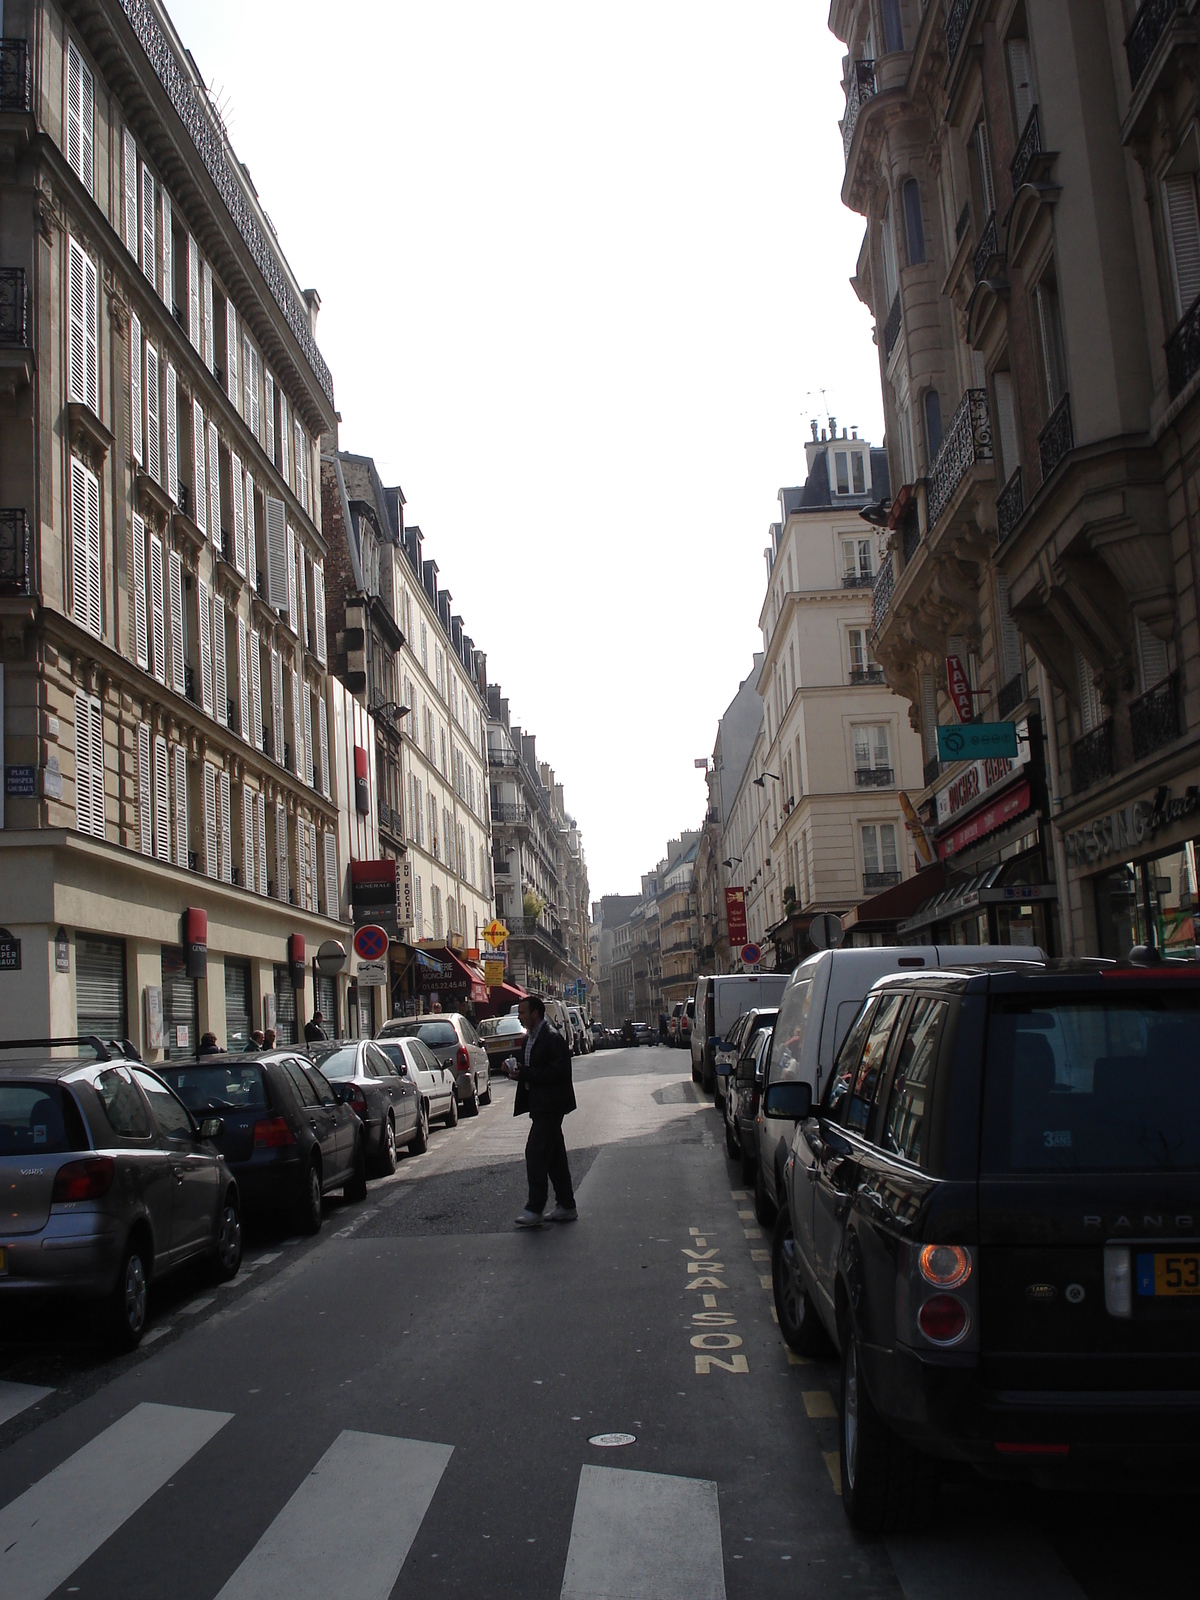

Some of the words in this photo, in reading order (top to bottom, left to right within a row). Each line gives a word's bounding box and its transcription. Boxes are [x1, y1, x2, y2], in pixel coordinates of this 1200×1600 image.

[949, 658, 971, 718] TABAC
[948, 766, 980, 815] ROCHER
[1064, 801, 1146, 868] PRESSING
[403, 864, 410, 877] DU
[1004, 887, 1041, 898] LOTO
[404, 883, 412, 920] ROCHER
[423, 971, 453, 980] MONCEAU
[422, 980, 467, 991] 01.45.22.45.48
[1054, 1136, 1072, 1145] ANS
[1083, 1215, 1194, 1229] RANG
[1165, 1257, 1200, 1289] 53
[1143, 1278, 1150, 1288] F
